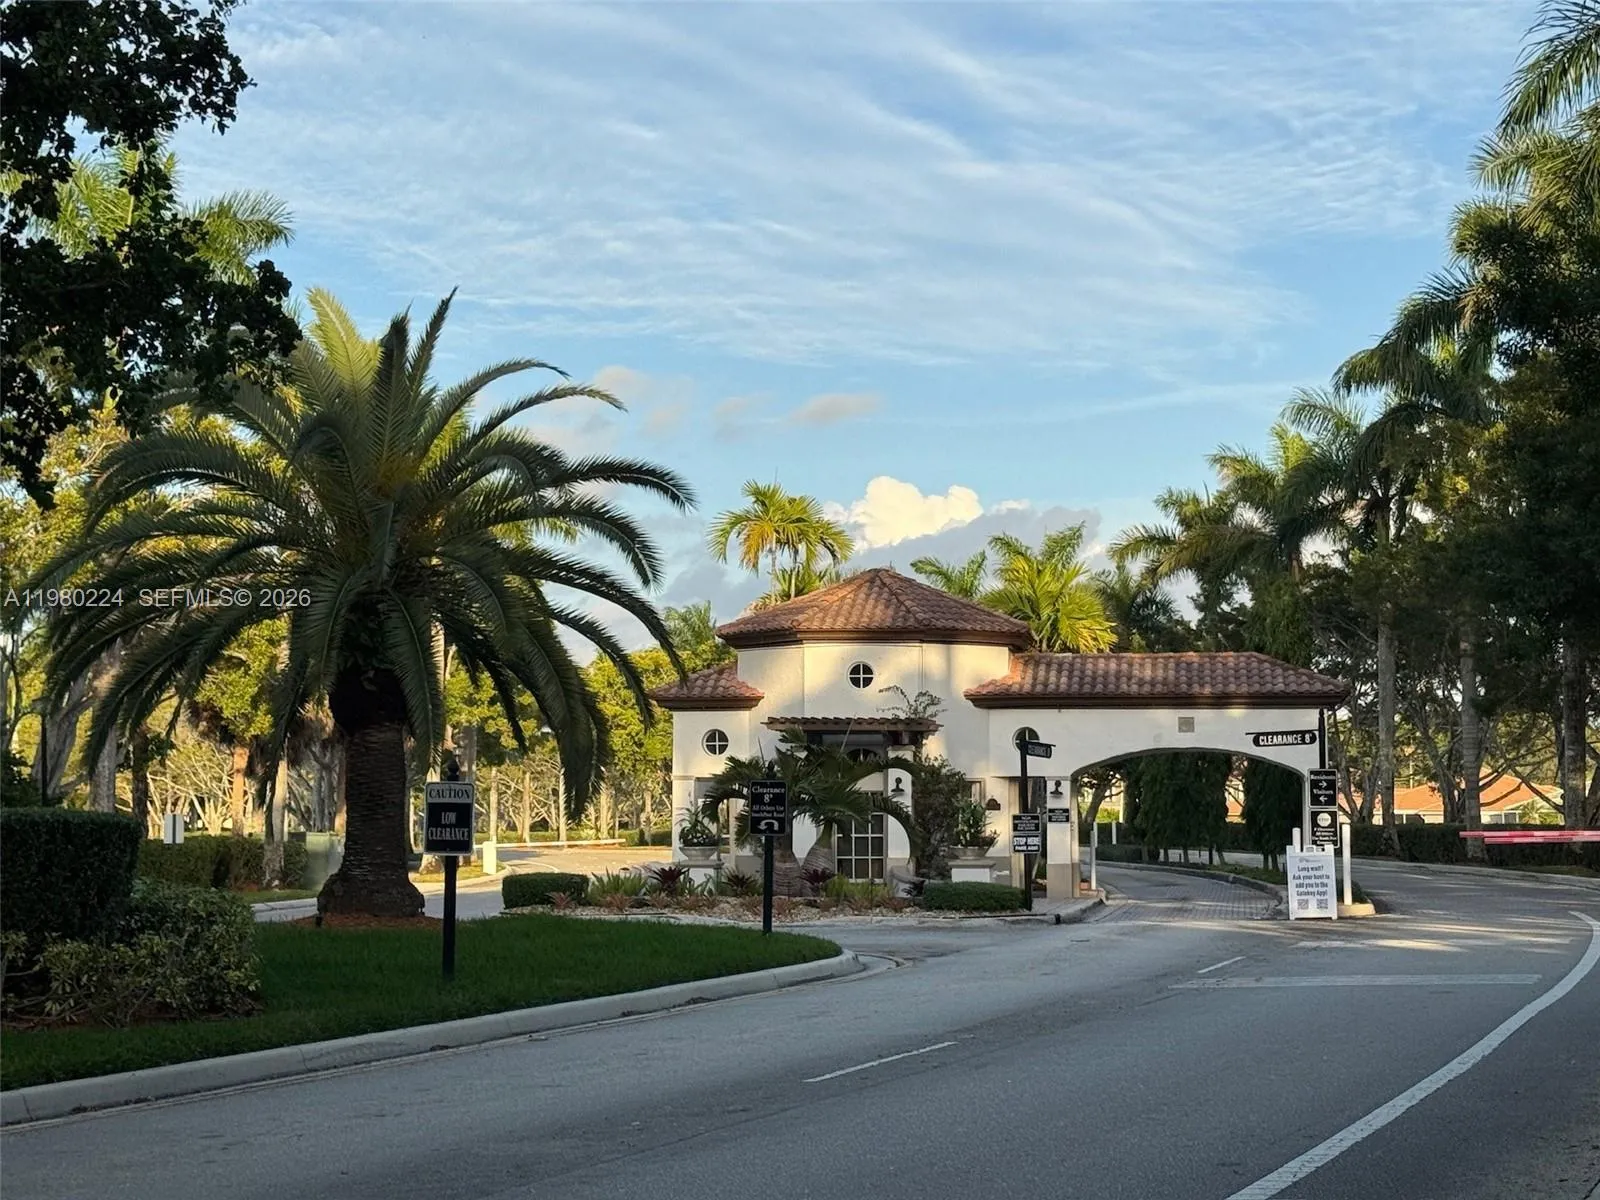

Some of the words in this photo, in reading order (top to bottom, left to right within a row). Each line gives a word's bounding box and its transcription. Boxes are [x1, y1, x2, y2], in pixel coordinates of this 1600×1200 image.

[1259, 734, 1303, 746] CLEARANCE
[429, 787, 470, 800] CAUTION
[751, 785, 785, 793] Clearance
[441, 811, 457, 825] LOW
[428, 827, 469, 841] CLEARANCE
[1013, 837, 1026, 846] STOP
[1297, 865, 1310, 873] Long
